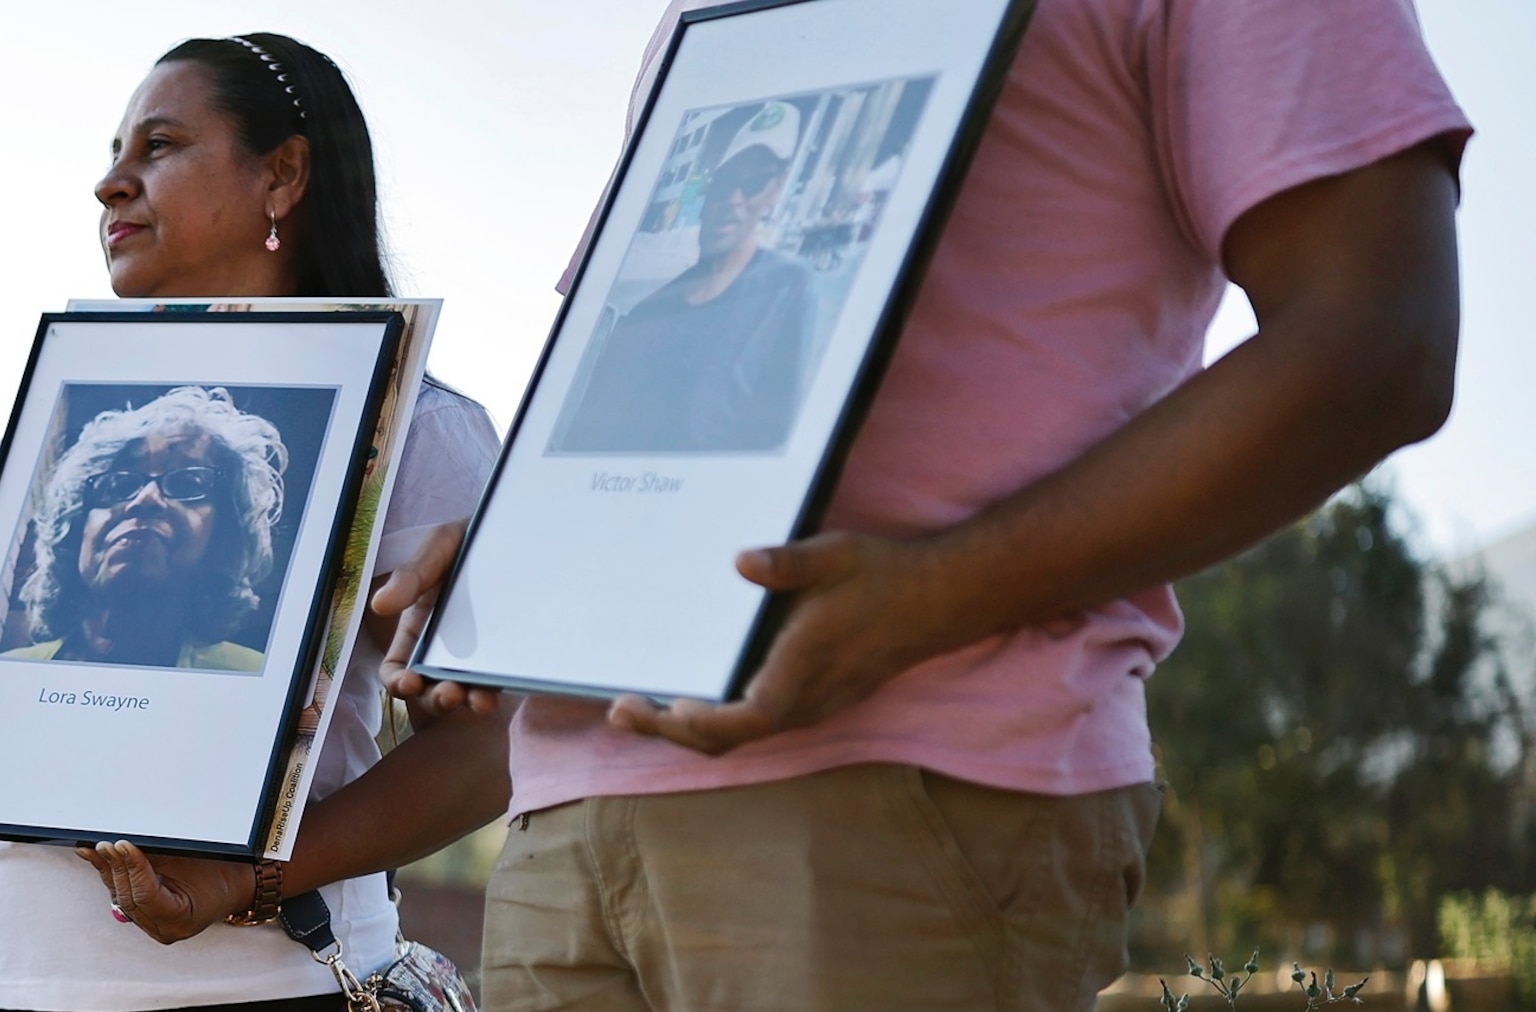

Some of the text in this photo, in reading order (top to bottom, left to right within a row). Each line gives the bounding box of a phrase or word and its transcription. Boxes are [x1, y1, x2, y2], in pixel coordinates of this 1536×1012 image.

[591, 471, 686, 493] Victor Shaw
[38, 687, 150, 712] Lora Swayne
[270, 762, 303, 852] DenaRiseUp Coalition
